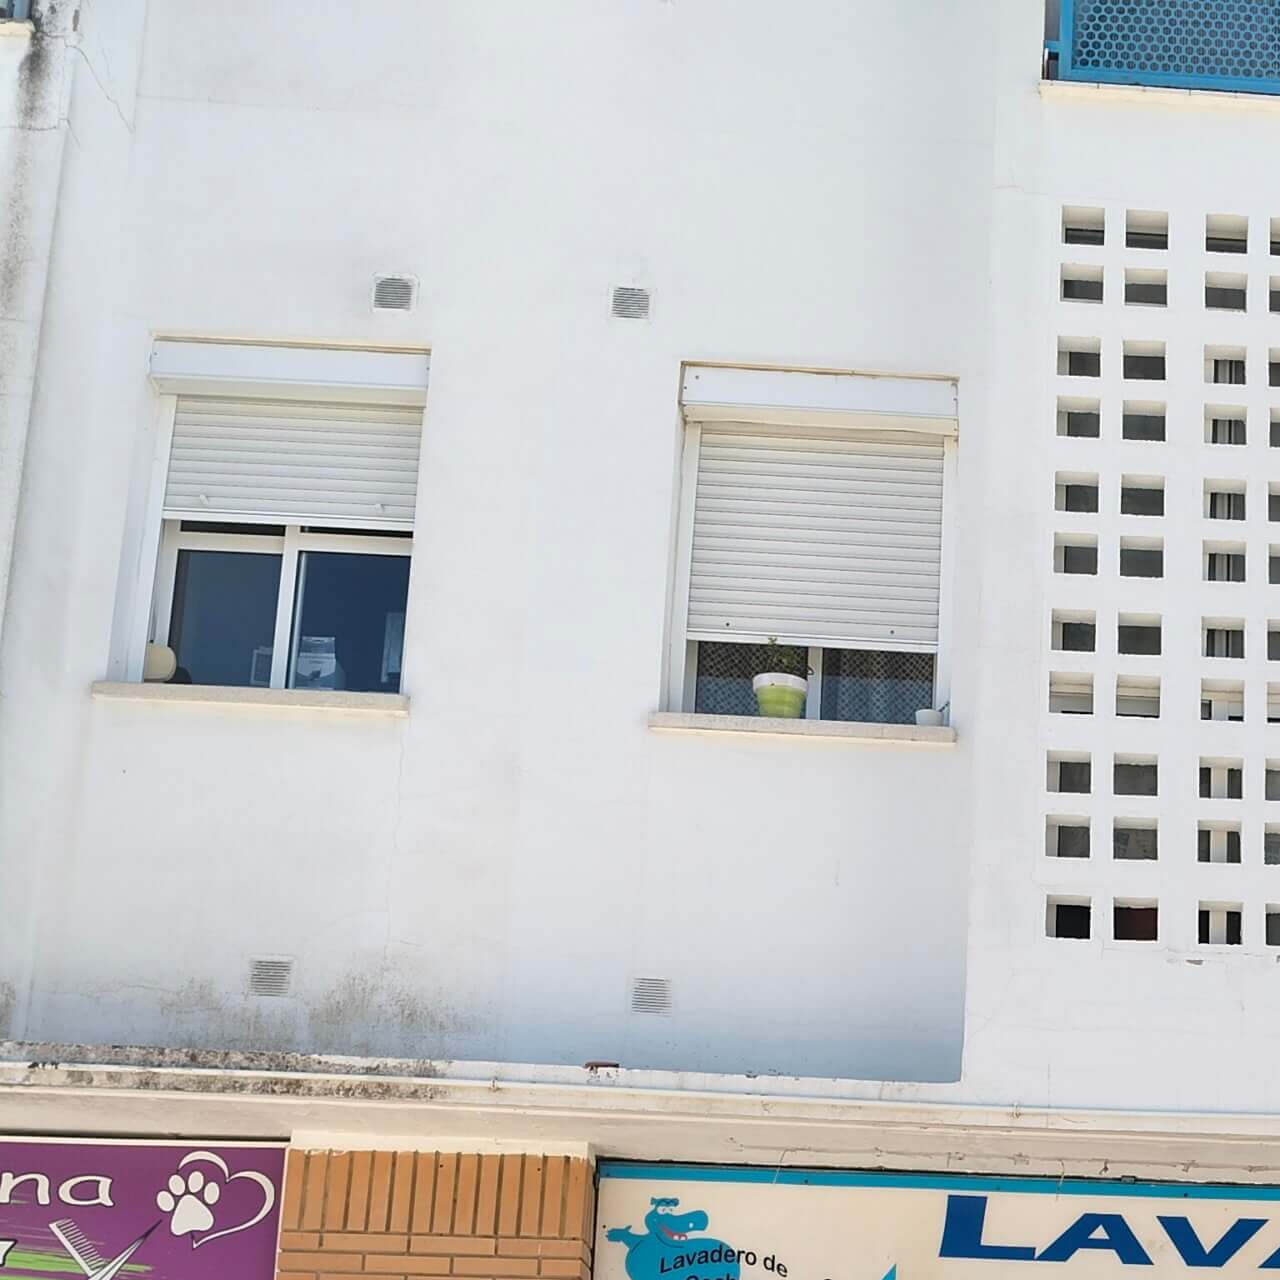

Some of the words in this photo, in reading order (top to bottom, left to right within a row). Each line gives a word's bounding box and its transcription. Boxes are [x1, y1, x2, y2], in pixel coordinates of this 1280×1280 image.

[0, 1172, 113, 1206] na
[660, 1245, 757, 1274] Lavadero
[763, 1255, 788, 1277] de
